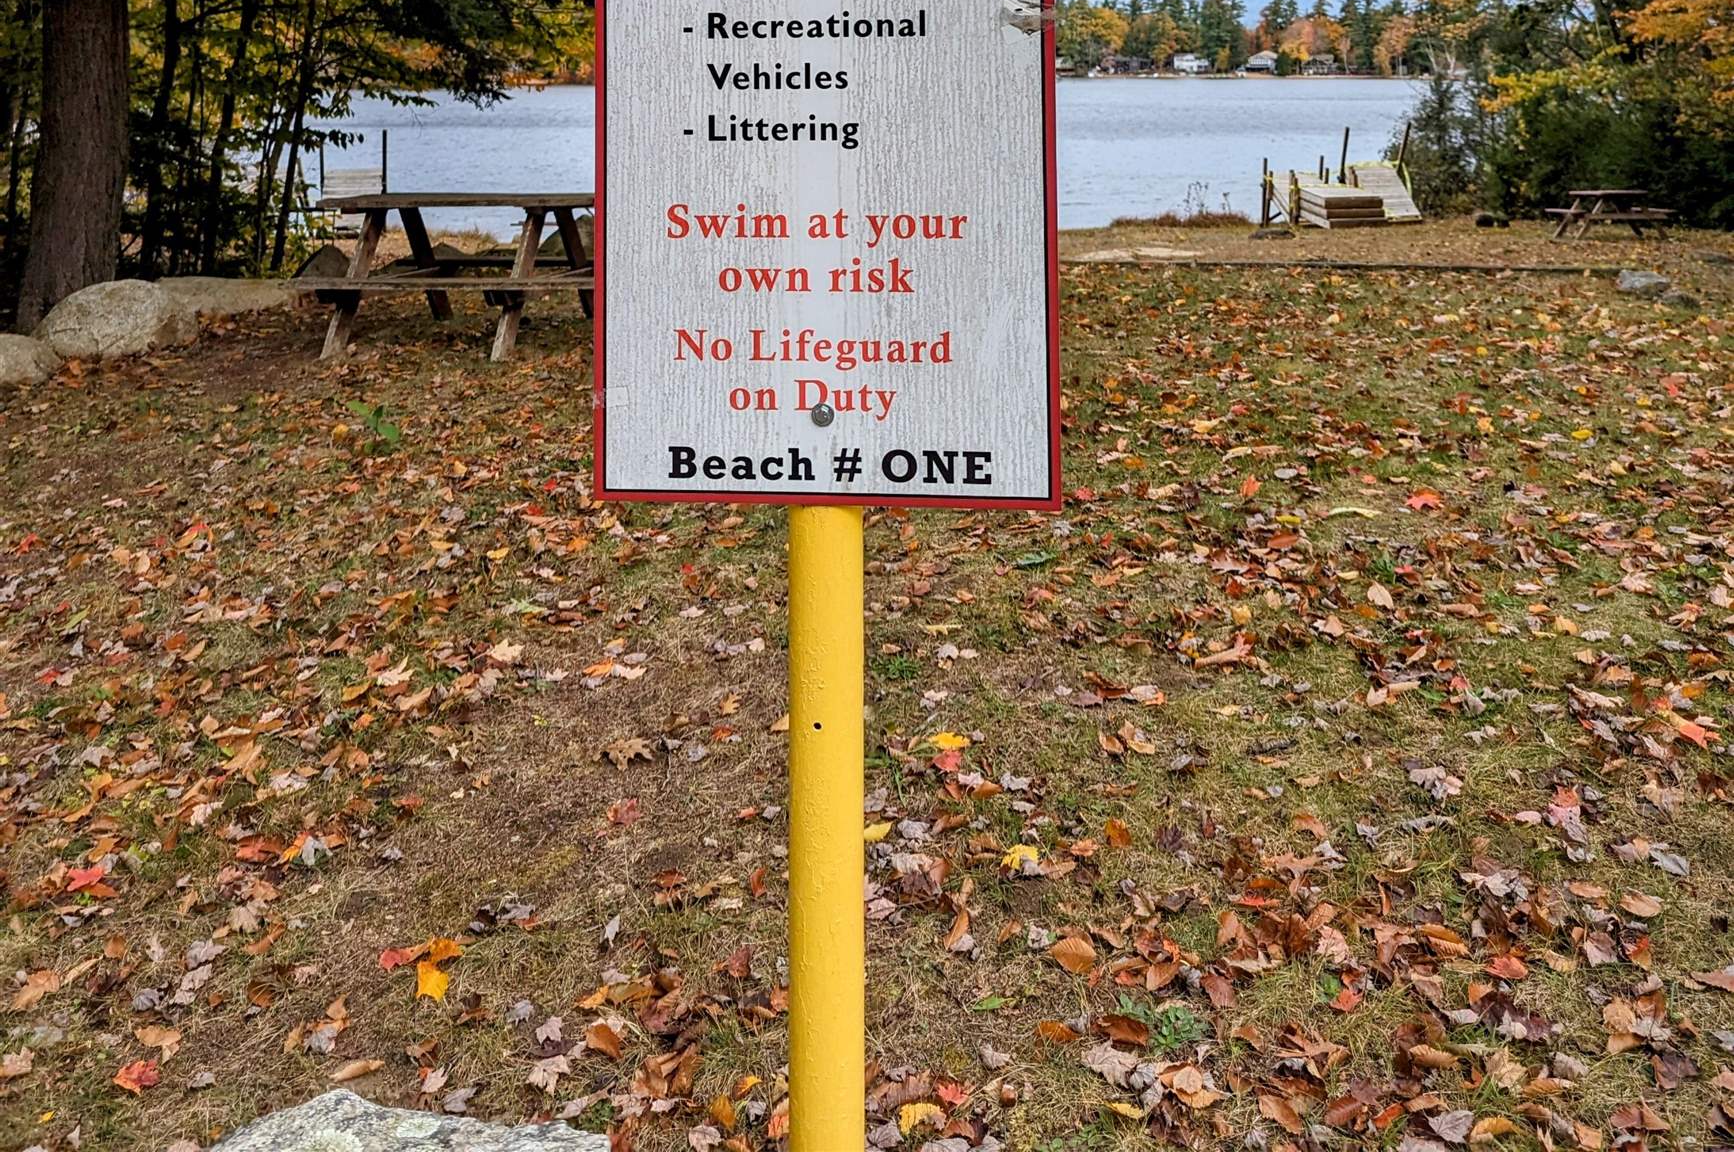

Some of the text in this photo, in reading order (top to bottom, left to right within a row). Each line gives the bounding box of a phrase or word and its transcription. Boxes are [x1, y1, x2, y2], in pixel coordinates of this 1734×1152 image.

[707, 9, 926, 40] Recreational
[706, 62, 849, 90] Vehicles
[708, 114, 860, 150] Littering
[667, 203, 968, 249] Swim at your
[718, 257, 914, 293] own risk
[675, 329, 953, 371] No Lifeguard
[729, 379, 897, 421] on Duty
[668, 446, 992, 485] Beach # ONE
